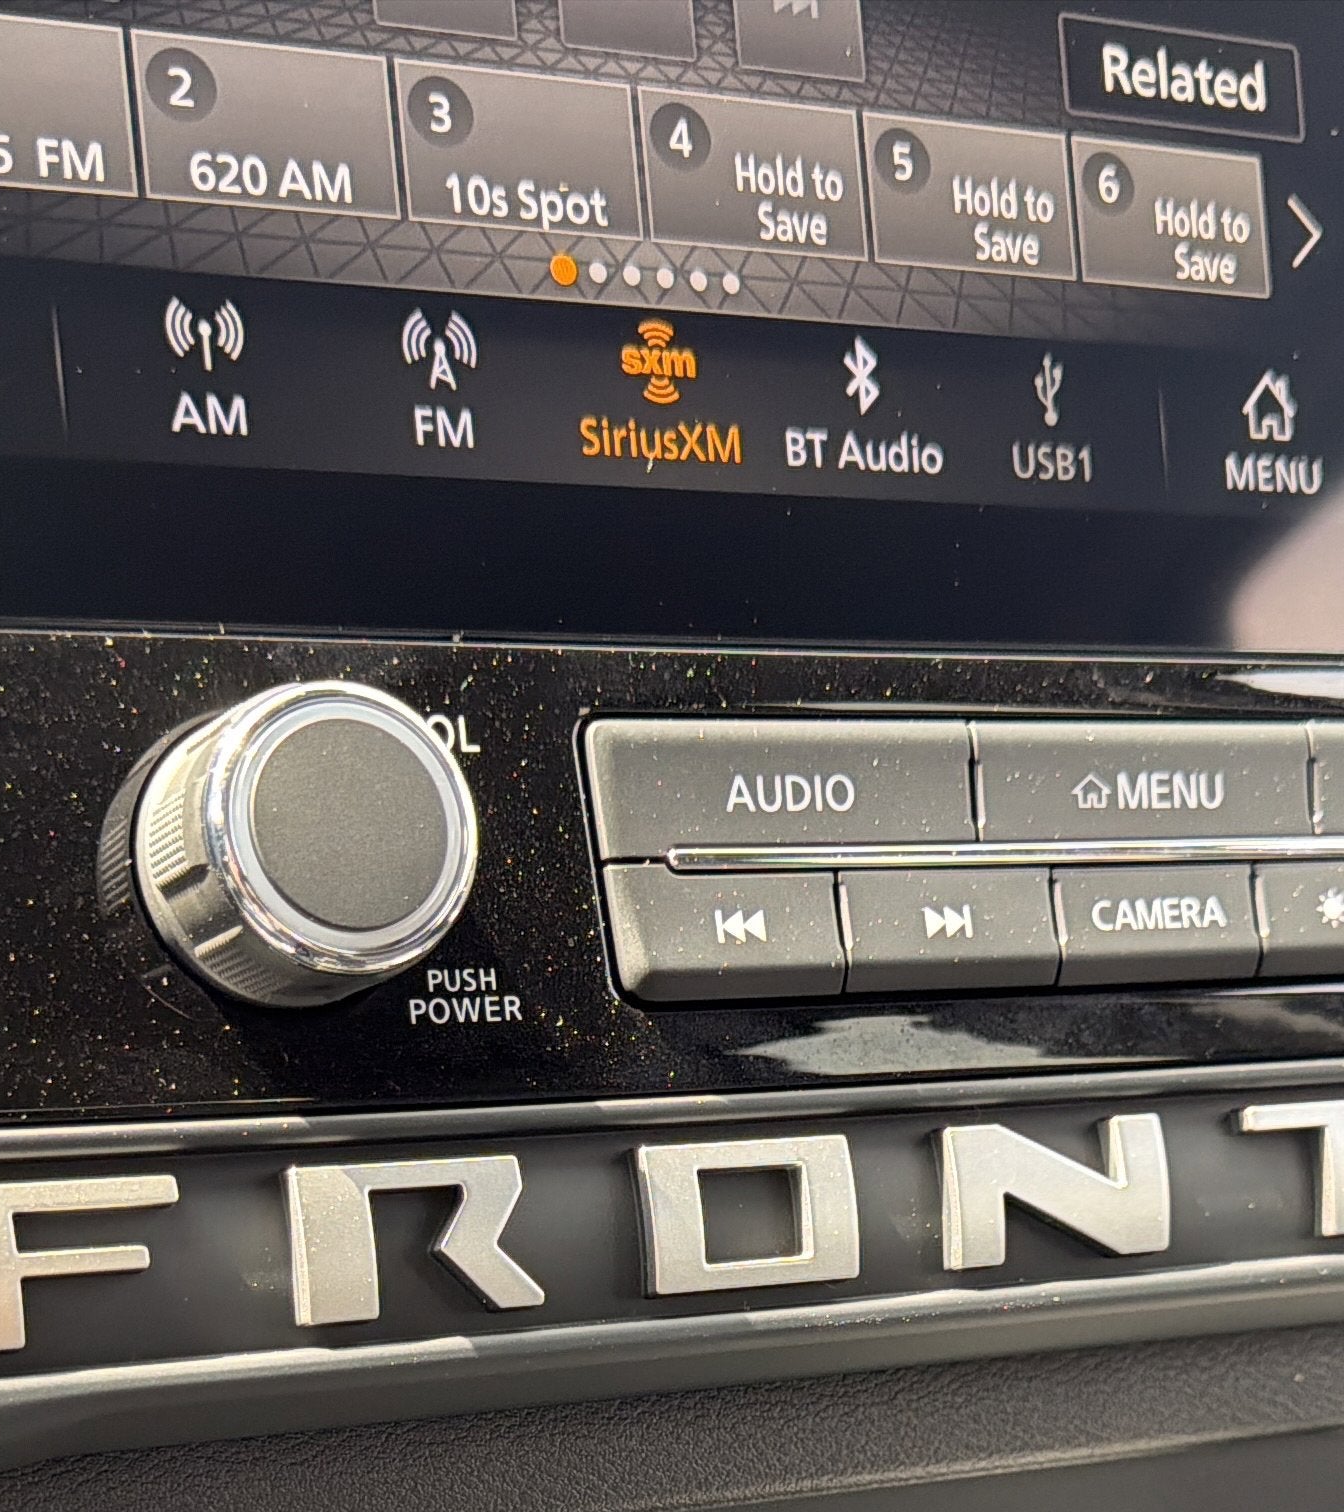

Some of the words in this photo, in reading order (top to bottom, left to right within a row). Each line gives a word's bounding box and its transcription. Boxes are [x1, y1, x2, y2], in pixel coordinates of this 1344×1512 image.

[167, 67, 194, 107] 2
[1101, 43, 1268, 113] Related
[429, 95, 452, 133] 3
[36, 137, 106, 183] FM
[668, 119, 693, 159] 4
[190, 153, 267, 197] 620
[278, 159, 352, 204] AM
[736, 151, 805, 201] Hold
[811, 163, 844, 203] to
[893, 142, 913, 182] 5
[446, 174, 508, 217] 10s
[518, 181, 608, 231] Spot
[953, 175, 1018, 224] Hold
[1023, 186, 1055, 226] to
[1098, 167, 1121, 205] 6
[758, 202, 828, 247] Save
[1154, 199, 1215, 242] Hold
[1220, 206, 1250, 245] to
[974, 225, 1040, 267] Save
[1174, 244, 1236, 286] Save
[171, 395, 248, 438] AM
[414, 406, 474, 451] FM
[580, 416, 741, 464] SiriusXM
[785, 429, 828, 471] BT
[836, 430, 944, 476] Audio
[1012, 441, 1092, 483] USB1
[1224, 453, 1322, 496] MENU
[426, 714, 480, 752] OL
[726, 774, 855, 813] AUDIO
[1117, 770, 1225, 810] MENU
[1092, 896, 1228, 932] CAMERA
[427, 968, 497, 993] PUSH
[409, 996, 522, 1026] POWER
